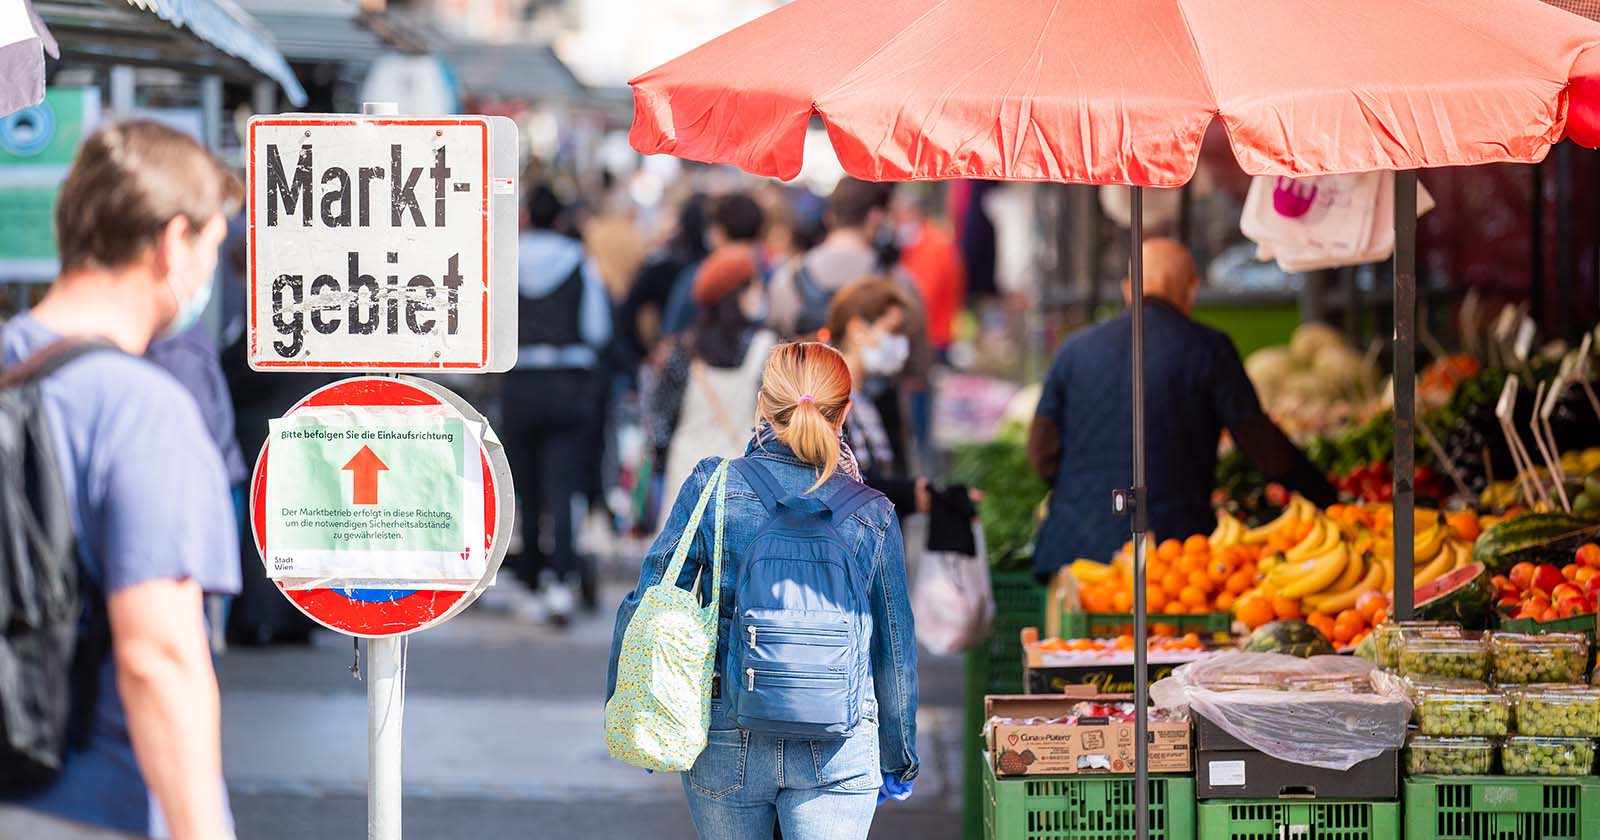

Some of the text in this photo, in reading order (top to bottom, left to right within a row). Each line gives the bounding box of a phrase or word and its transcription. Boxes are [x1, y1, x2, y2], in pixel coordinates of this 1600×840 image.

[266, 144, 470, 227] Markt-
[272, 251, 464, 358] gebiet
[281, 430, 453, 442] Bitte befolgen Sie die Einkaufsrichtung
[281, 507, 453, 520] Der Marktbetrieb erfolgt in diese Richtung,
[300, 519, 314, 527] die
[315, 520, 368, 530] notwendigen
[369, 520, 450, 529] Sicherheitsabstände
[343, 530, 404, 541] gewährleisten.
[274, 556, 294, 564] Stadt
